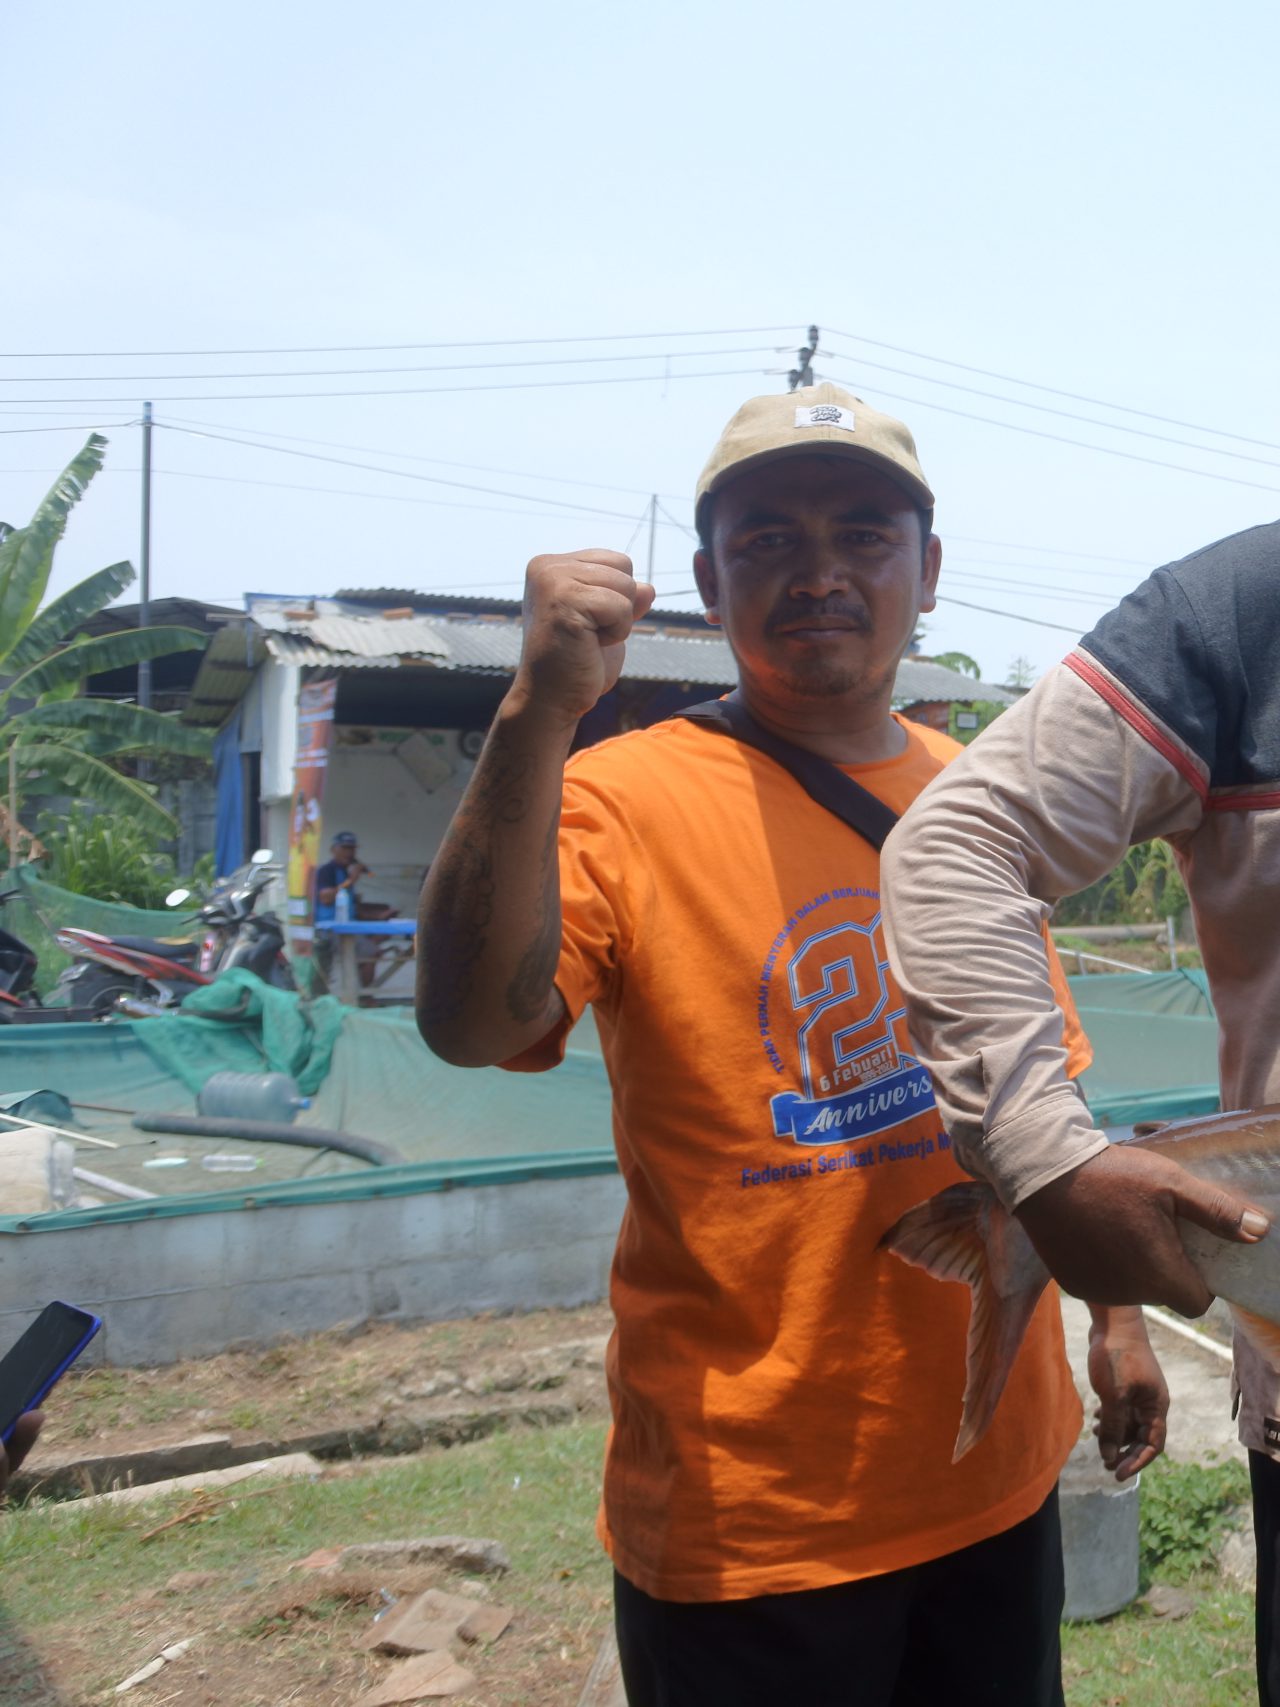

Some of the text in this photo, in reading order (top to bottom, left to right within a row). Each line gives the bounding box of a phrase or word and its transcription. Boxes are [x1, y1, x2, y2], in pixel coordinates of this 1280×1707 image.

[803, 1075, 933, 1135] Annivers
[819, 1075, 831, 1092] 6
[741, 1130, 951, 1188] Federasi Serikat Pekerja M
